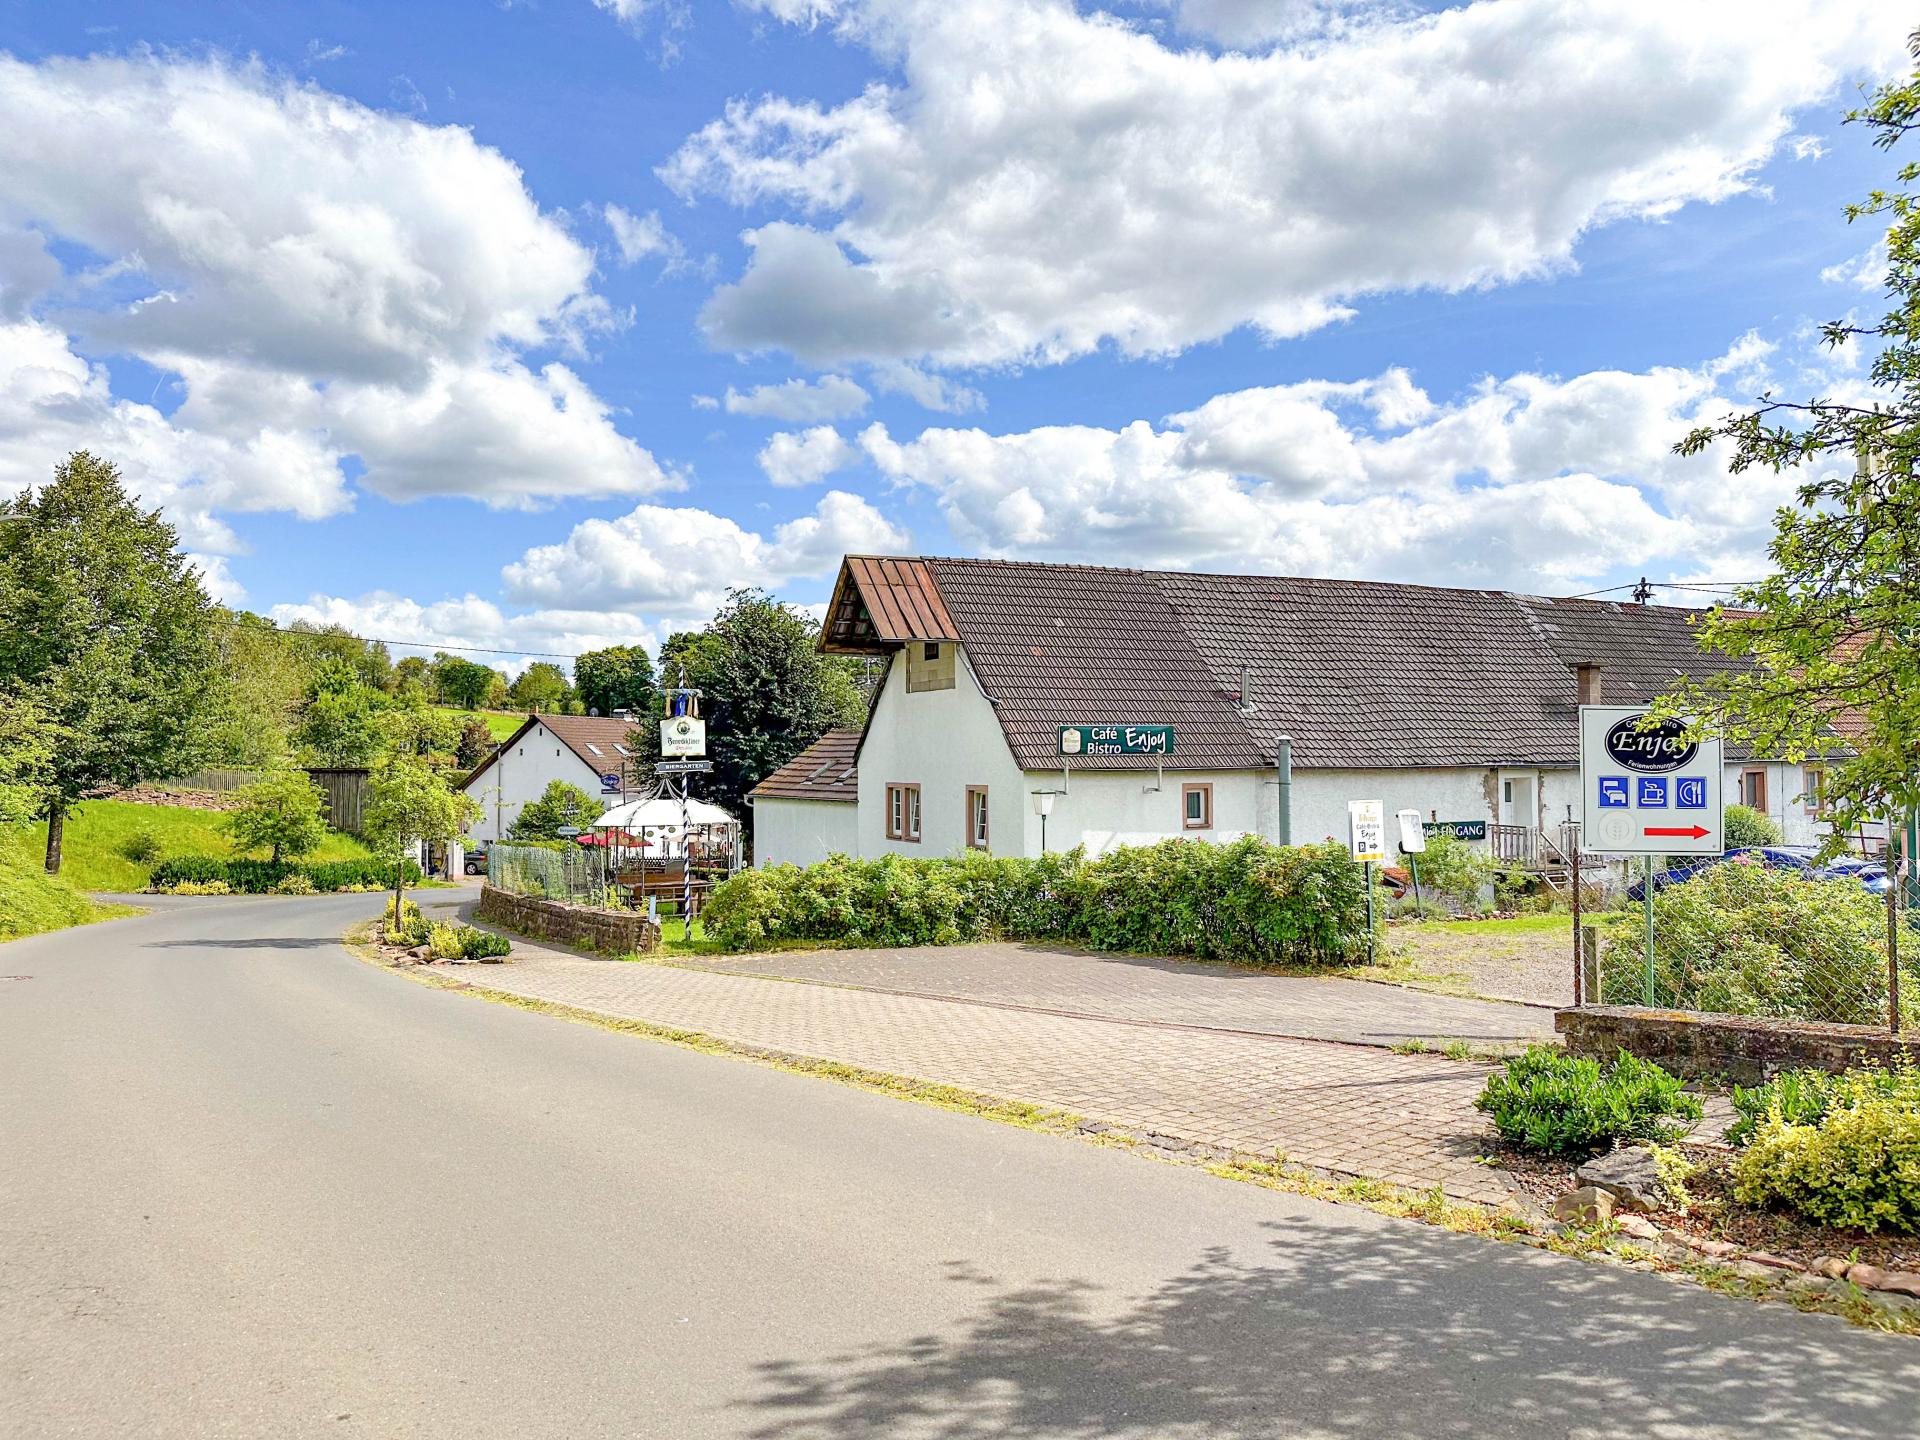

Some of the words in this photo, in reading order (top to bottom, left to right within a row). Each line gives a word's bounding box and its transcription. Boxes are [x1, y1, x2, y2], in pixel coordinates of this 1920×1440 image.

[1091, 727, 1117, 740] Café
[1124, 727, 1166, 754] Enjoy
[1087, 742, 1121, 754] Bistro
[1627, 759, 1678, 770] Ferienwohnungen
